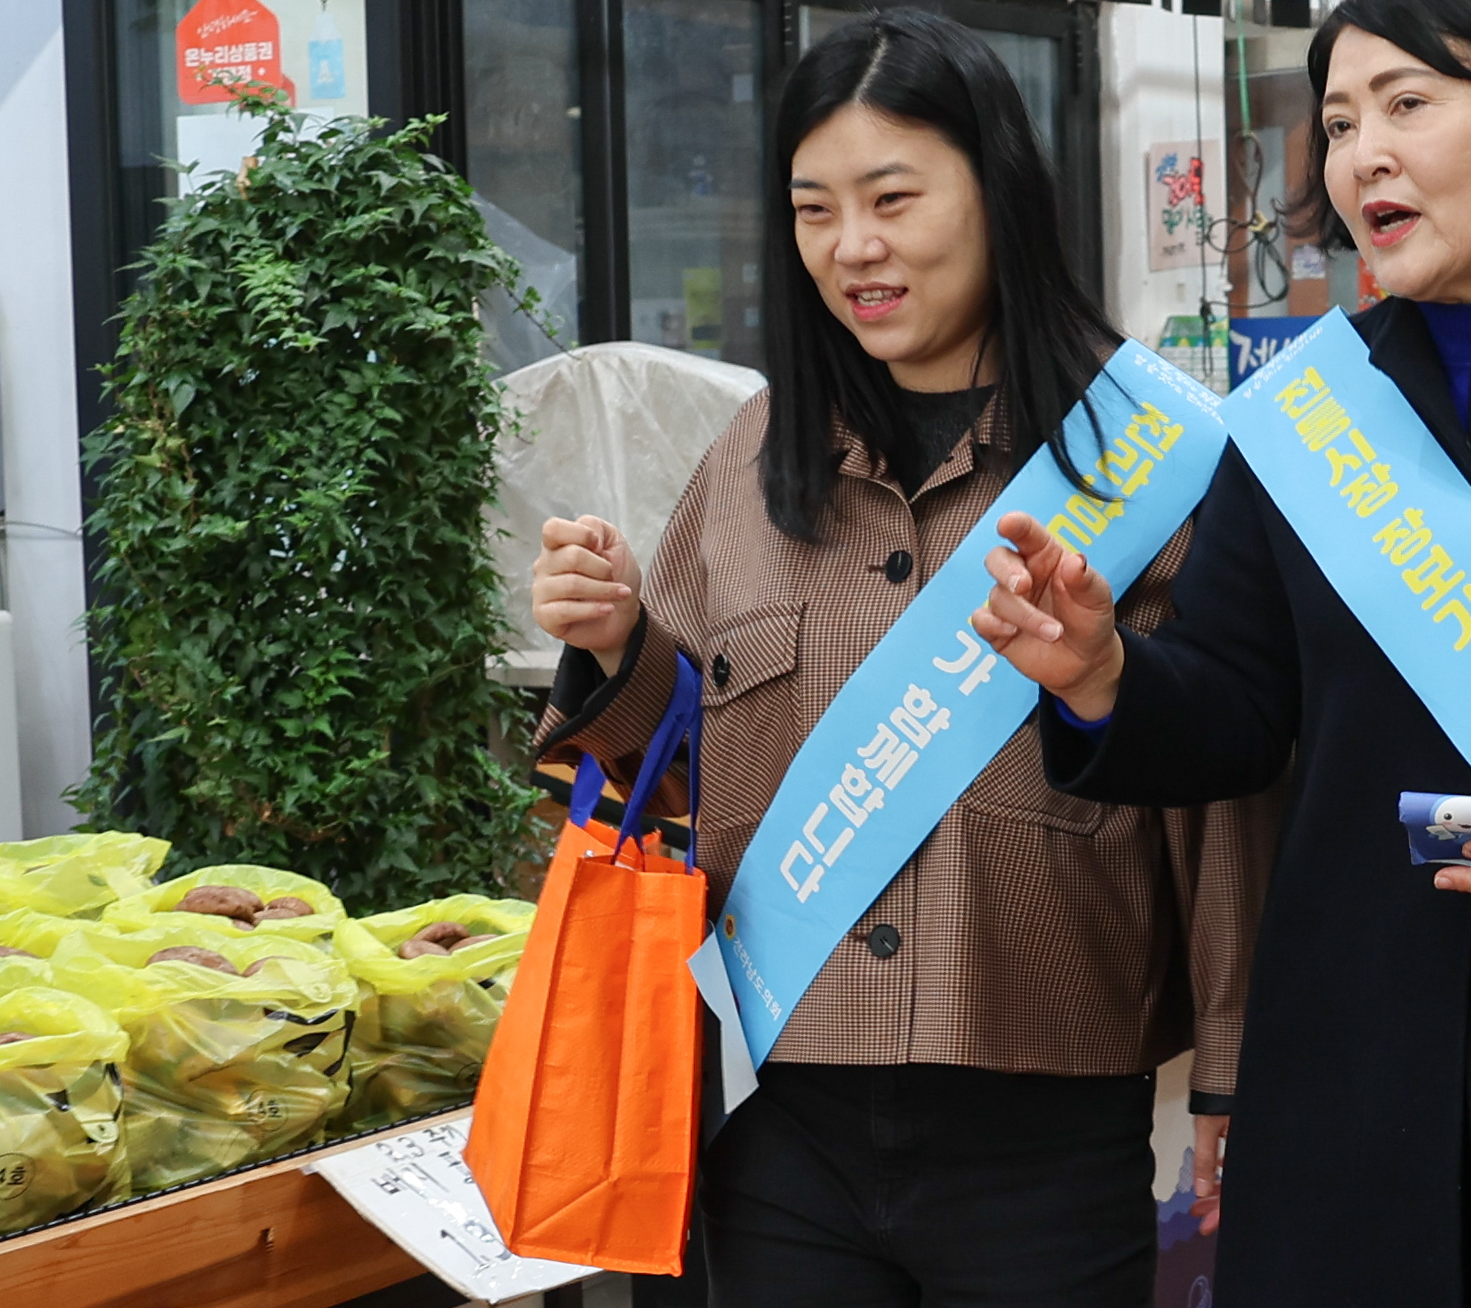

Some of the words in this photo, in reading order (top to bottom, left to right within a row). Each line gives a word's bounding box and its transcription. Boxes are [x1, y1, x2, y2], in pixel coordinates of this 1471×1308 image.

[184, 41, 274, 67] 온누리상품권
[1275, 366, 1399, 520] 전통시장
[779, 683, 951, 904] 함께합니다
[732, 936, 783, 1021] 전라남도의회
